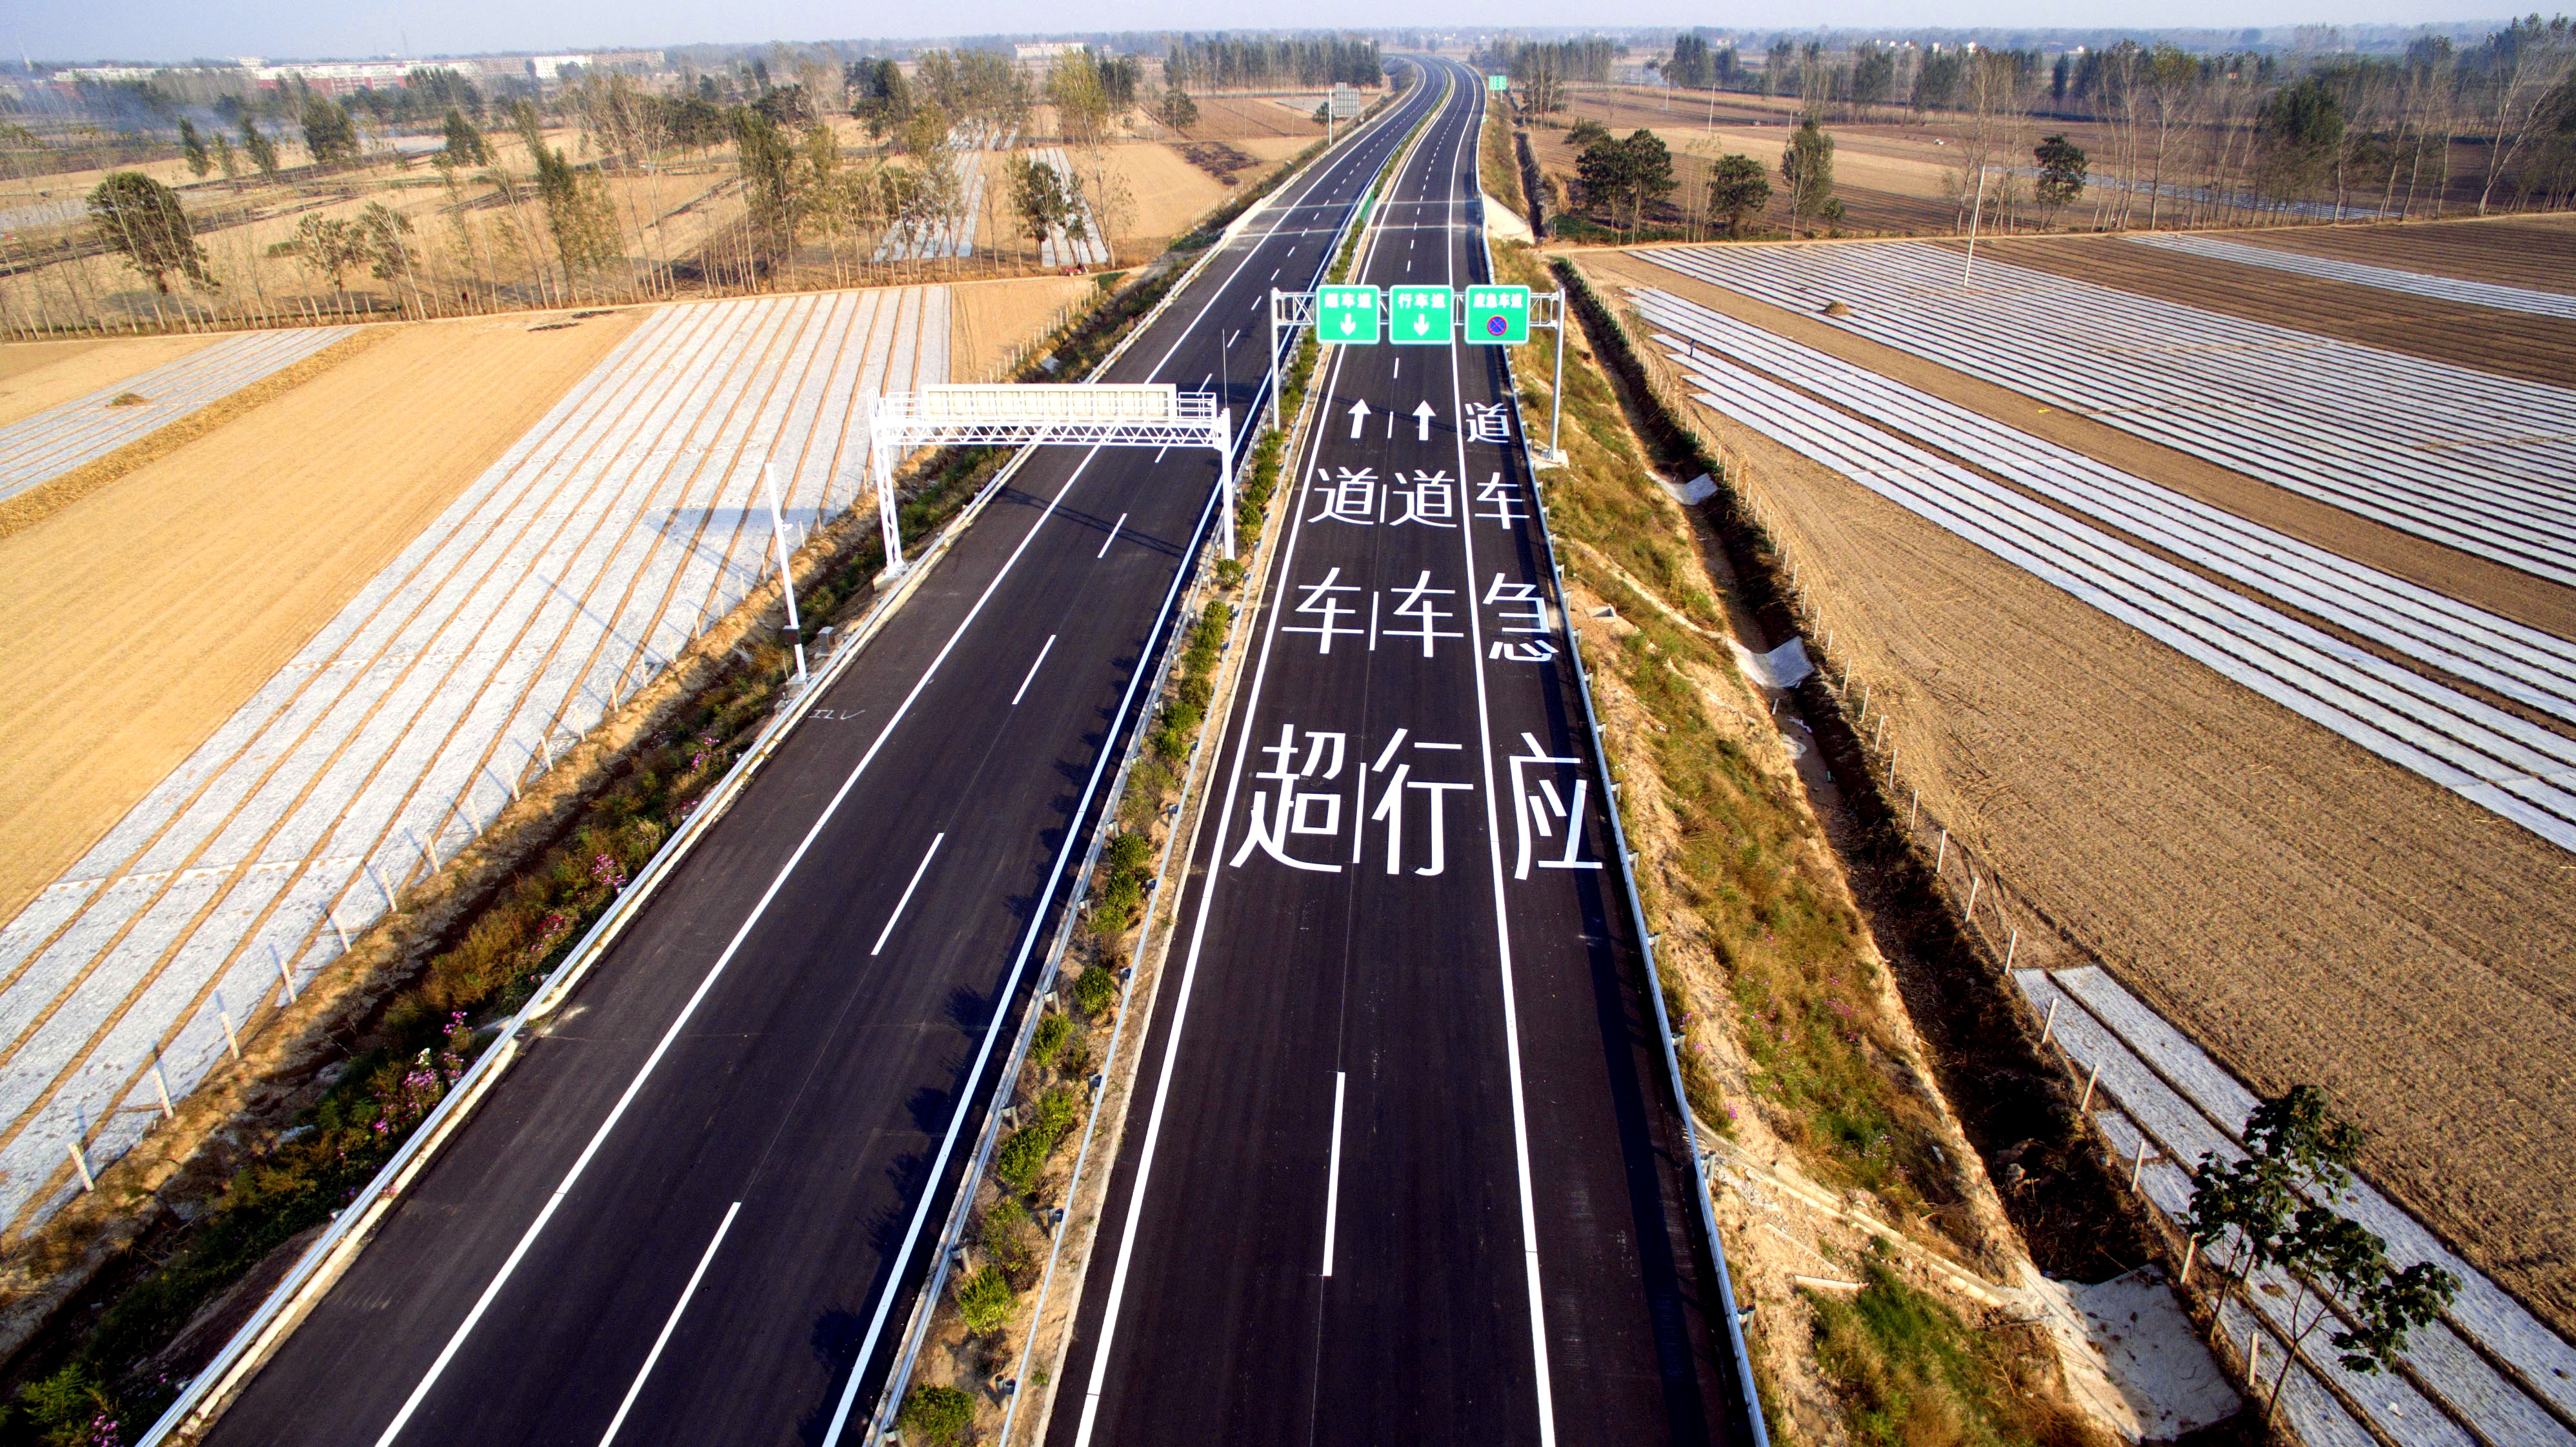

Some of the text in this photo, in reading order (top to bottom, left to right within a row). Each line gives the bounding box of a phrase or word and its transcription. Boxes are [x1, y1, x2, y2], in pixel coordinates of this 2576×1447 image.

[1398, 292, 1445, 309] 行车道
[1473, 292, 1523, 309] 应急车道
